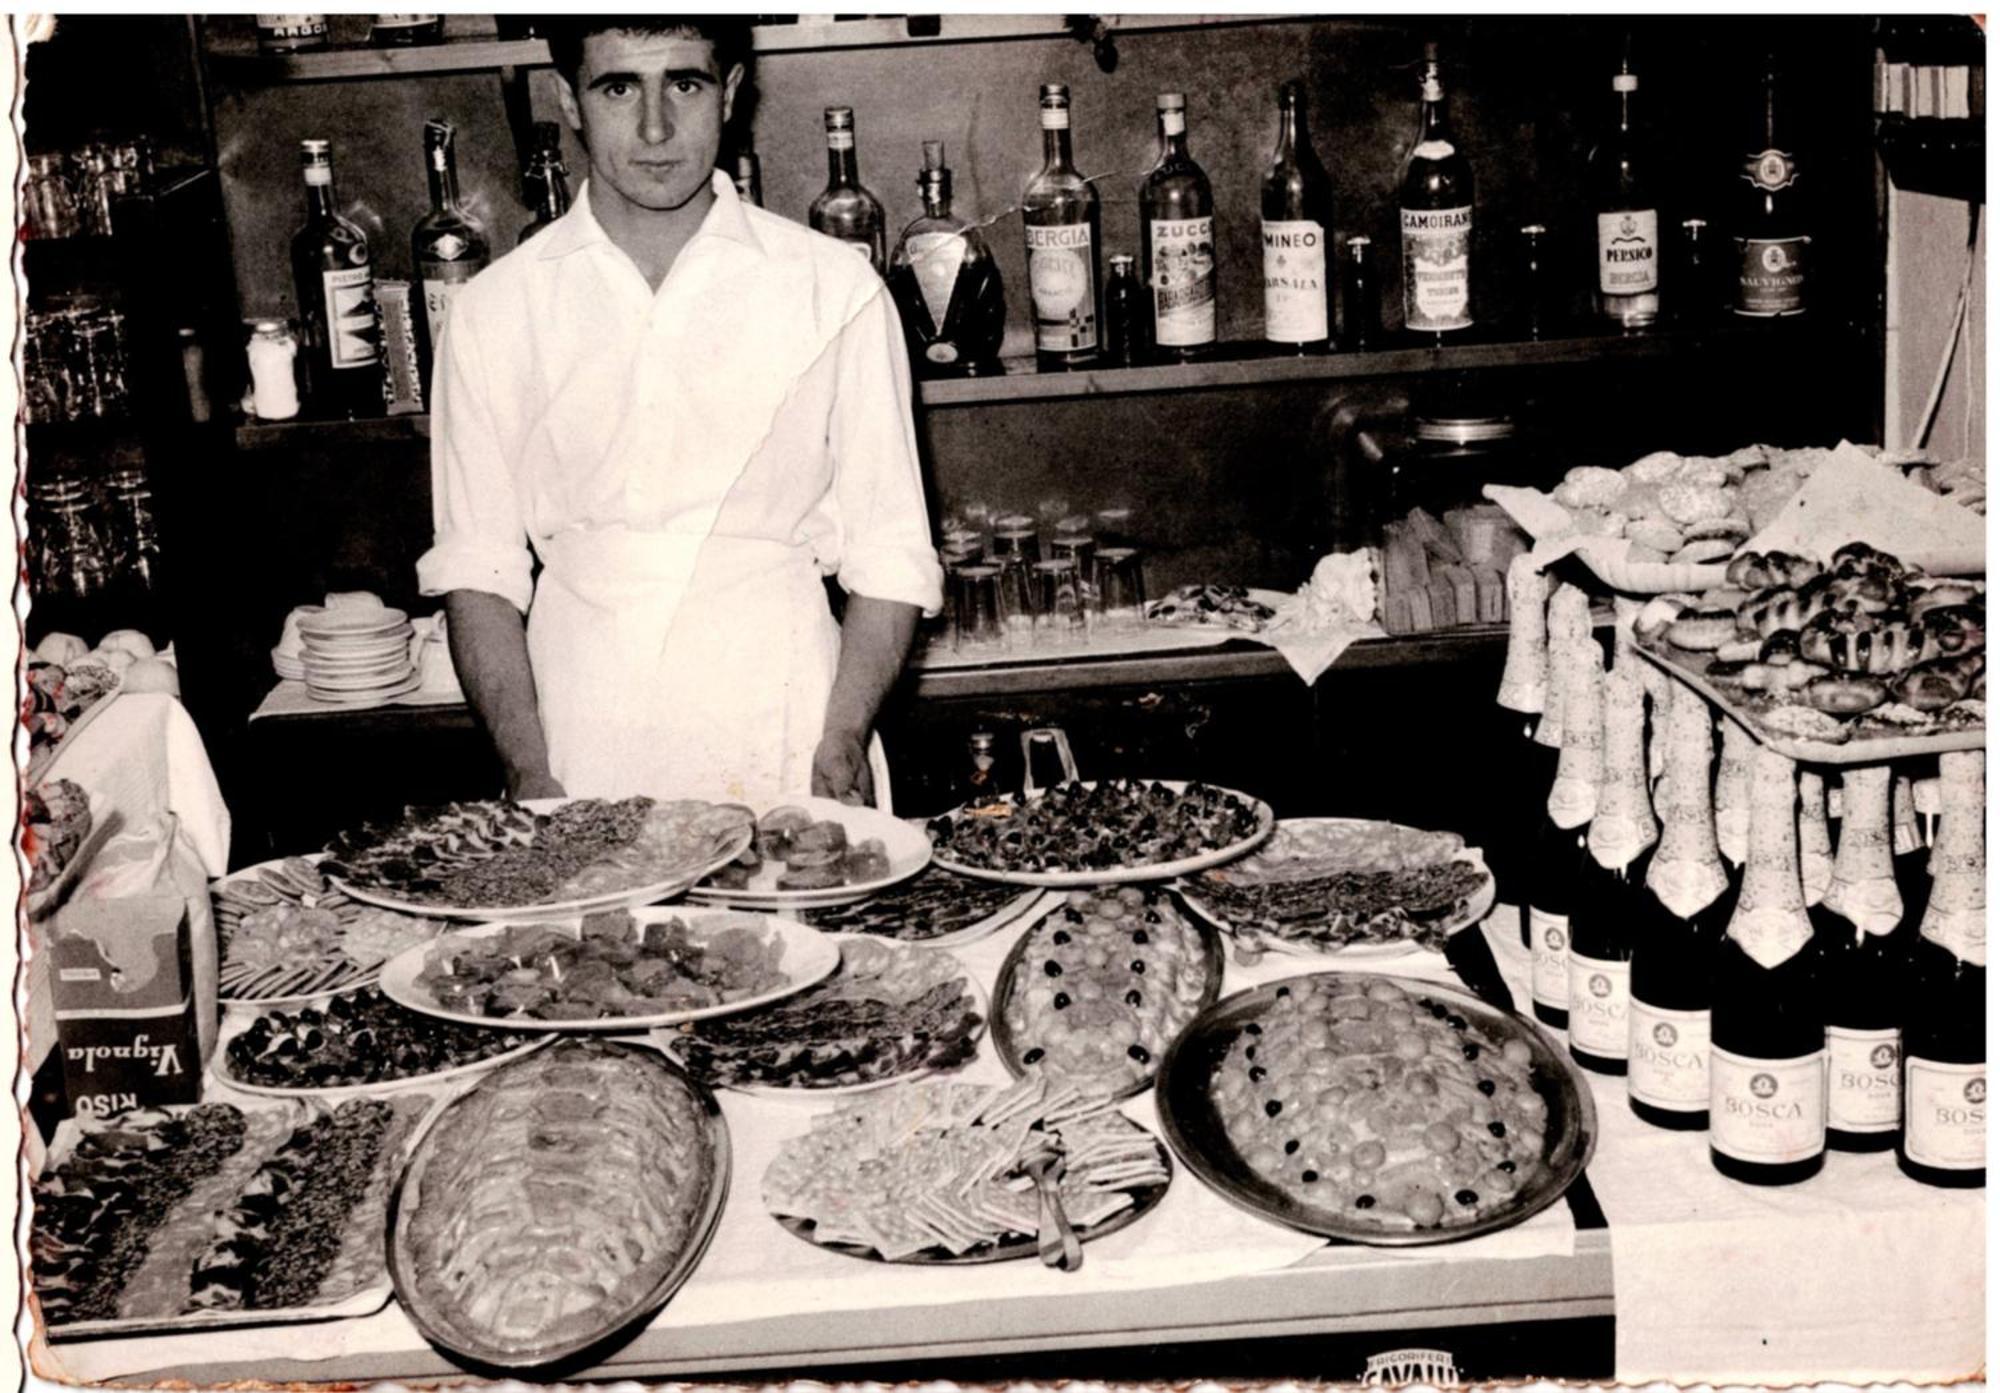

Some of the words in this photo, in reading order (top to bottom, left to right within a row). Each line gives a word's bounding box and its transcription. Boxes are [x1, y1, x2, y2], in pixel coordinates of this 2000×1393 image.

[1026, 228, 1089, 247] BERGIA
[1264, 232, 1317, 248] MINEO
[1606, 246, 1652, 262] PERSICO
[1264, 277, 1318, 289] ARSALA
[1572, 993, 1626, 1019] BOSC
[67, 1034, 183, 1077] Vignola
[1635, 1042, 1703, 1069] BOSCA
[1725, 1096, 1803, 1120] BOSCA
